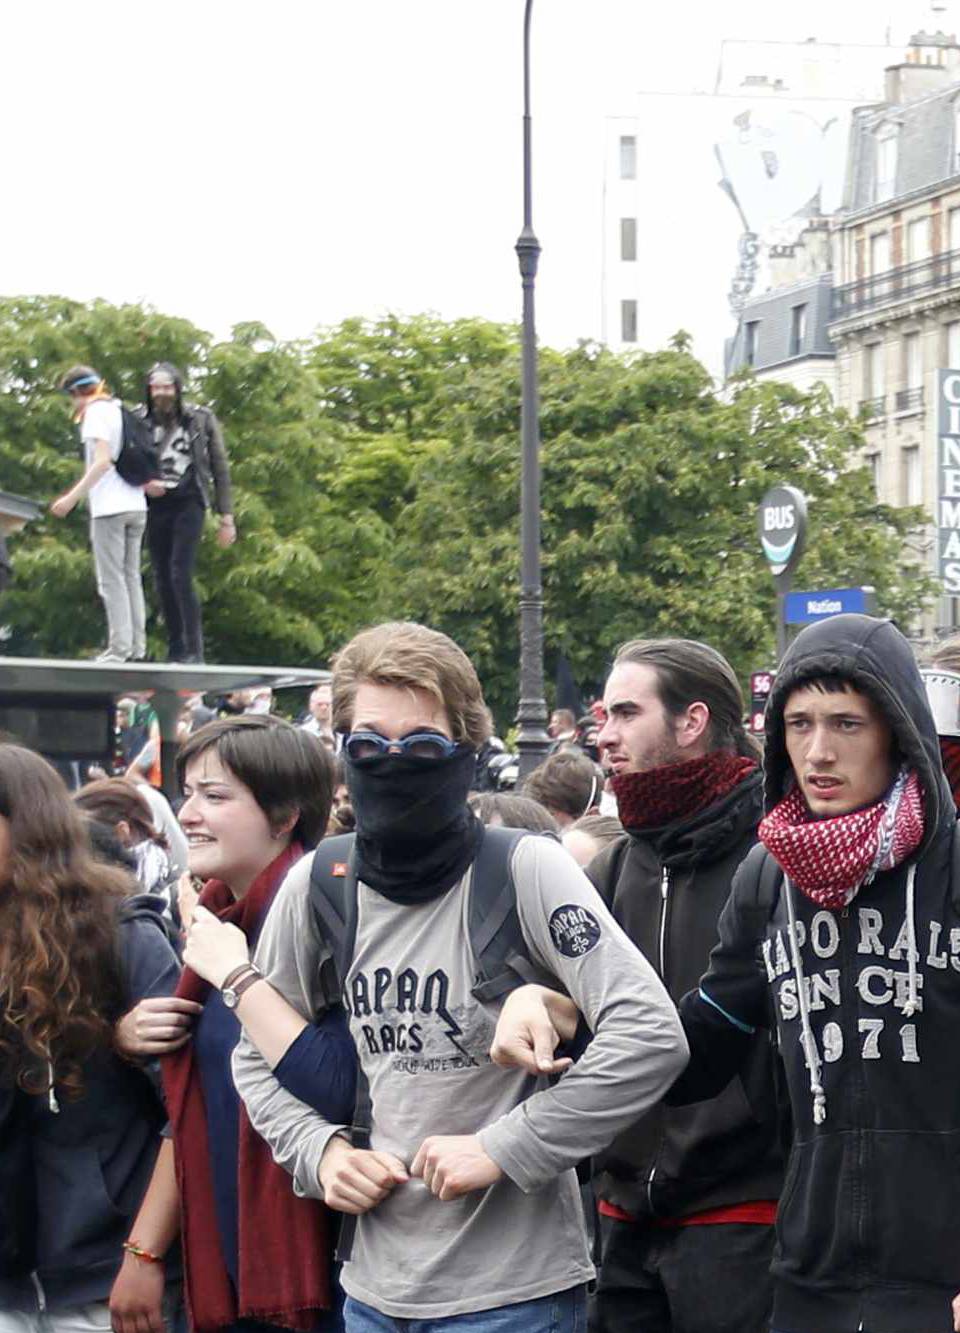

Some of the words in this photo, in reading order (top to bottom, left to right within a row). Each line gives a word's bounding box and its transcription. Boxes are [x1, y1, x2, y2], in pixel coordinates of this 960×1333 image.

[764, 505, 795, 531] BUS
[807, 599, 843, 614] Nation
[753, 675, 770, 693] 56
